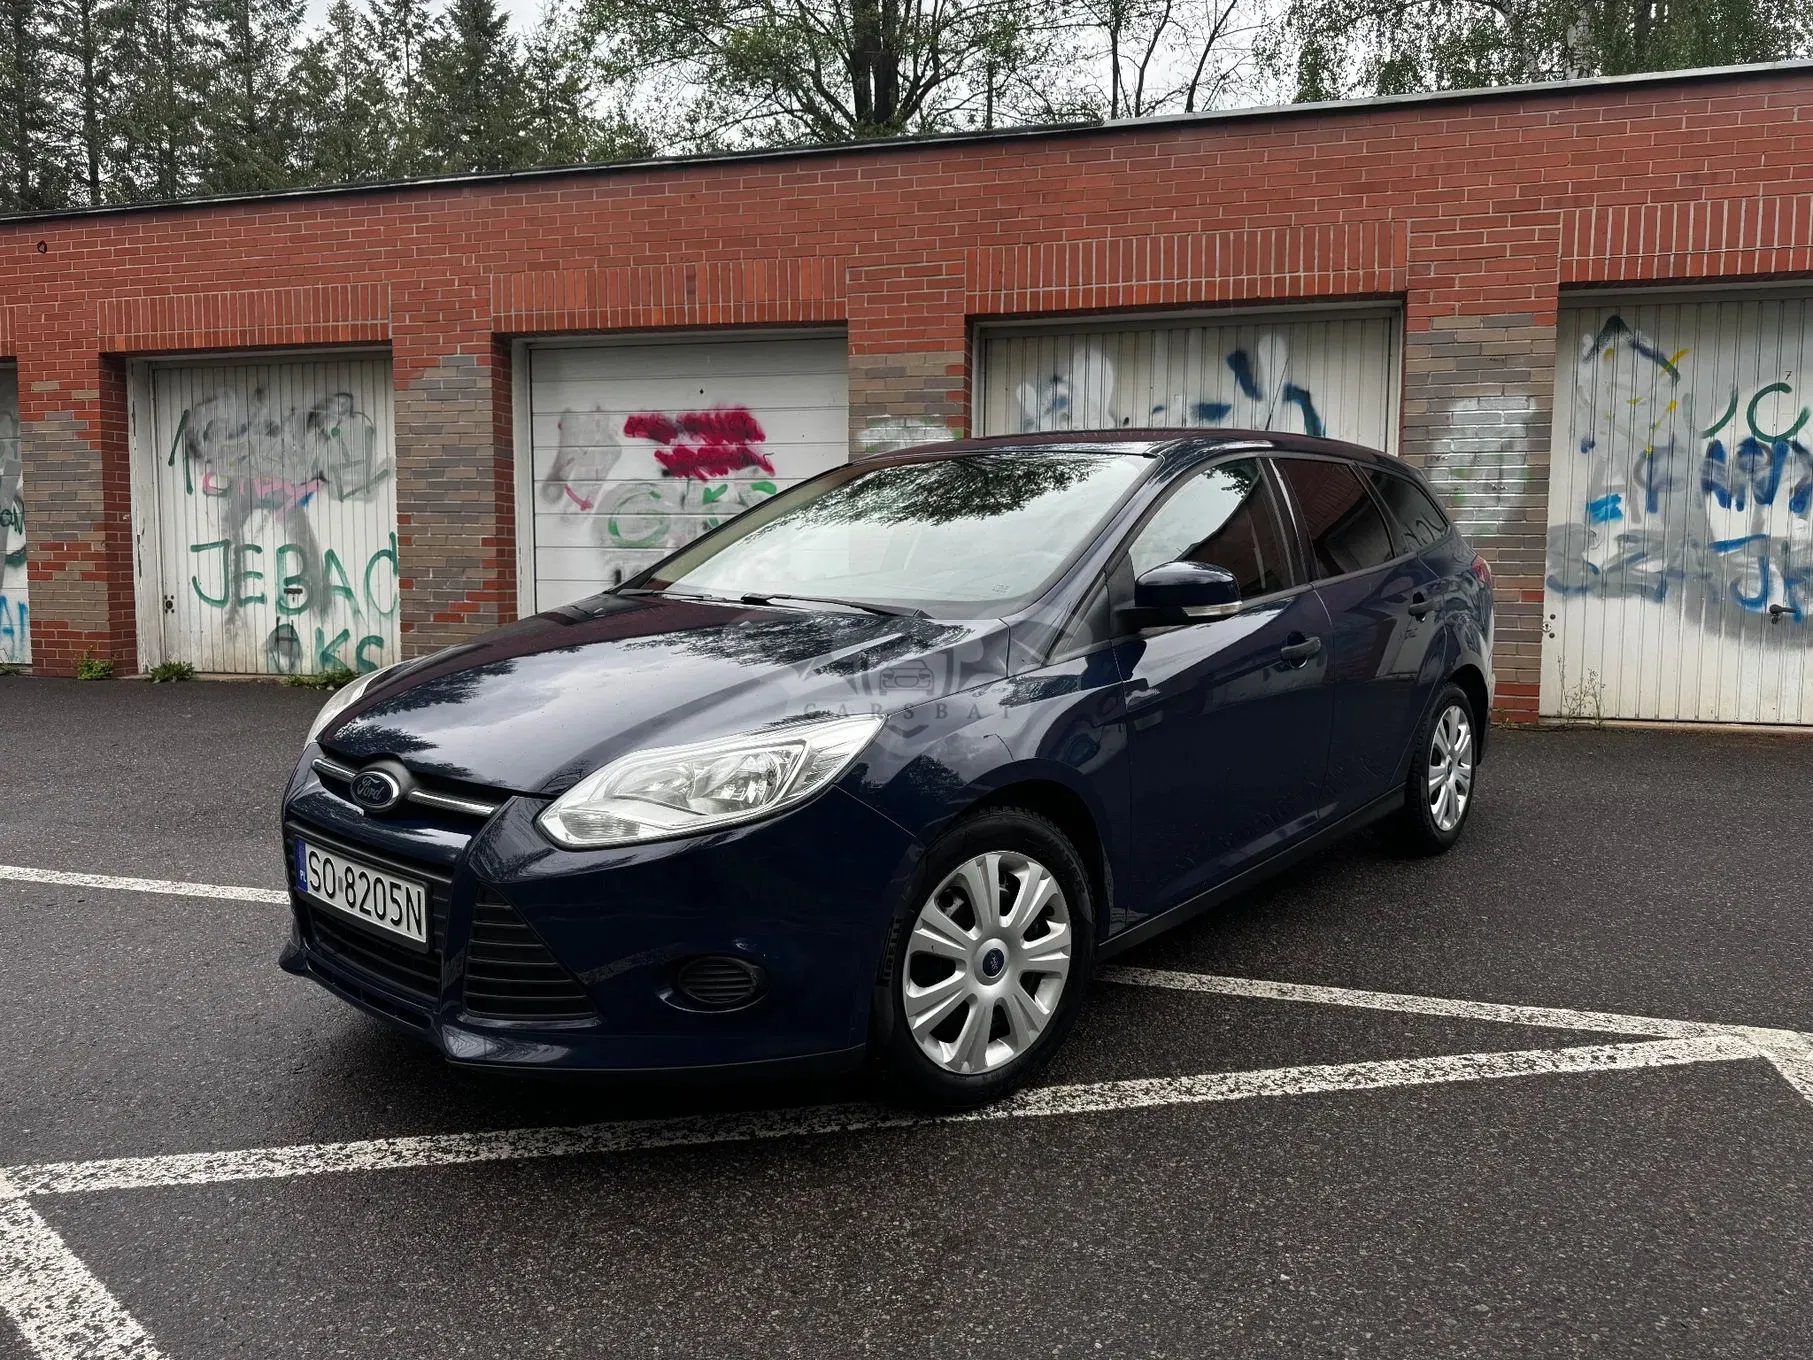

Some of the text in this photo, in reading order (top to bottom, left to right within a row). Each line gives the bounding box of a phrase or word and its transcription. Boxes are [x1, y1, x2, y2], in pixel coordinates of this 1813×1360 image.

[357, 776, 385, 800] Ford
[299, 869, 307, 883] PL
[309, 850, 422, 936] SO 8205N
